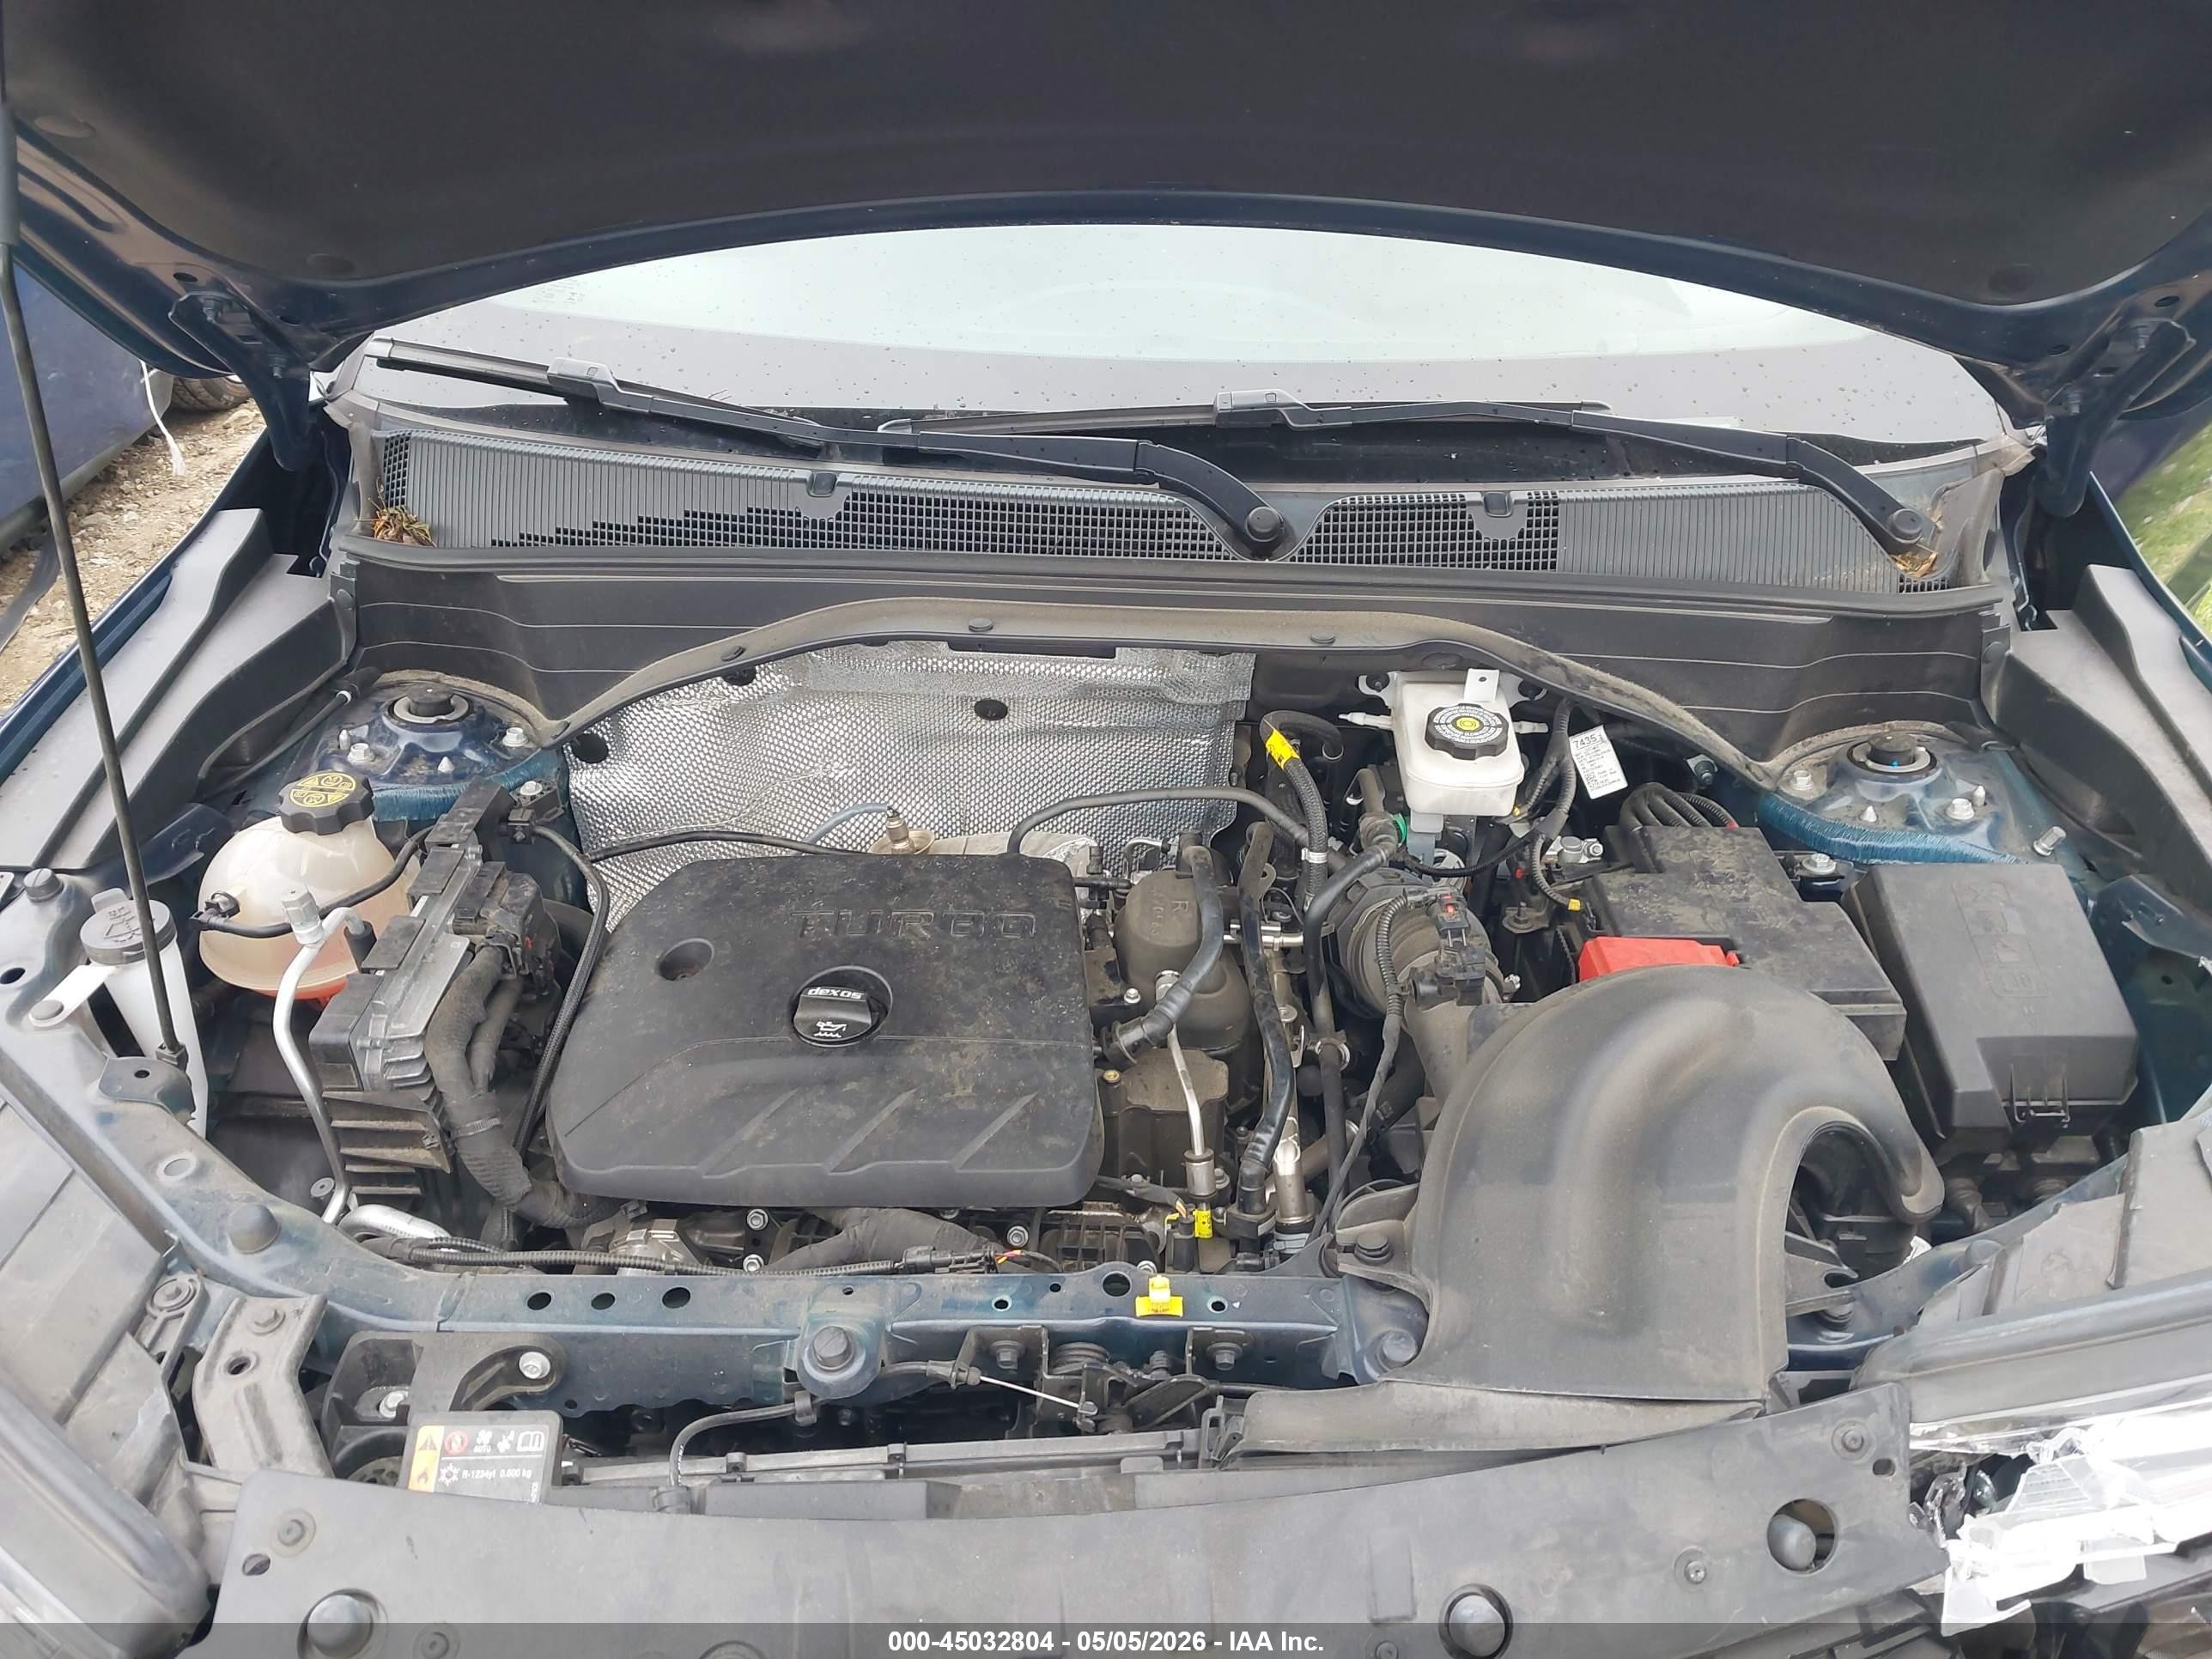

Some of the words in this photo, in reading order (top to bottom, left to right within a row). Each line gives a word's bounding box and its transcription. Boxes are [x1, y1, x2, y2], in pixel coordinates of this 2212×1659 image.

[1572, 734, 1597, 749] 7435
[790, 908, 1036, 939] TURBO
[807, 988, 862, 1000] dexos
[521, 1468, 532, 1479] kg
